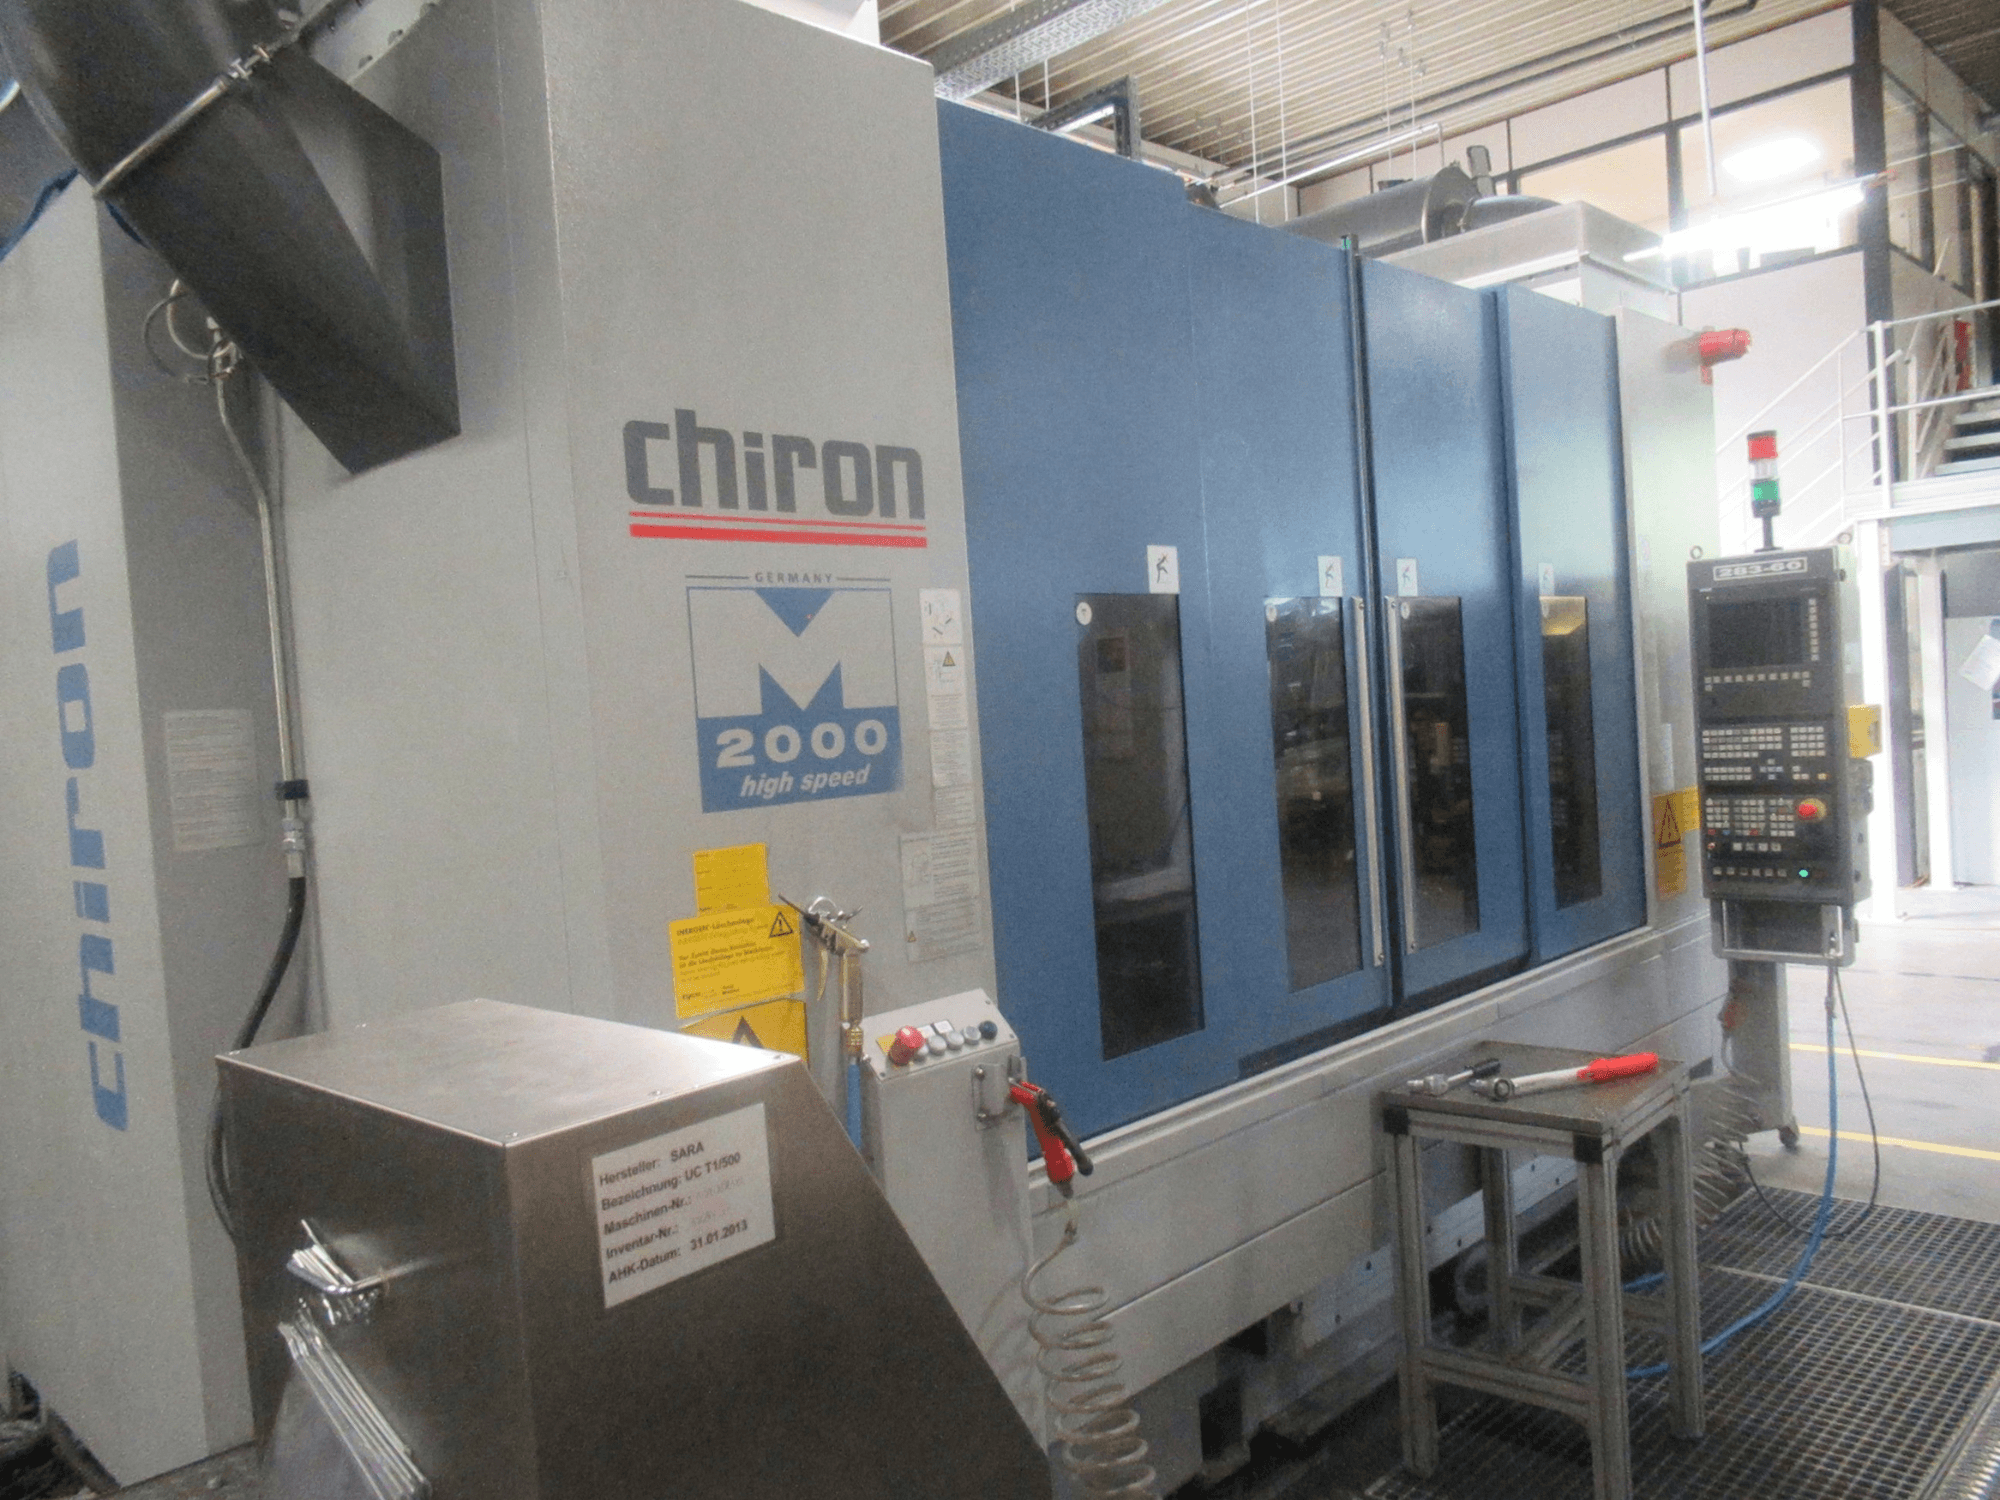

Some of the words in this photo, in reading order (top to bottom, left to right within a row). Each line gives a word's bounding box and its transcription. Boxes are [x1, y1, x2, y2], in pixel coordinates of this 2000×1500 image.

[622, 408, 926, 519] chiron
[754, 571, 833, 584] GERMANY
[716, 719, 888, 768] 2000
[740, 770, 793, 799] high
[800, 763, 871, 794] speed
[47, 538, 129, 1132] chiron
[600, 1158, 660, 1187] Hersteller:
[670, 1141, 704, 1163] SARA
[601, 1174, 682, 1211] Bezeichnung:
[685, 1164, 702, 1182] UC
[704, 1151, 741, 1175] T1/500
[608, 1247, 681, 1284] AHK-Datum:
[690, 1219, 748, 1251] 31.01.2013
